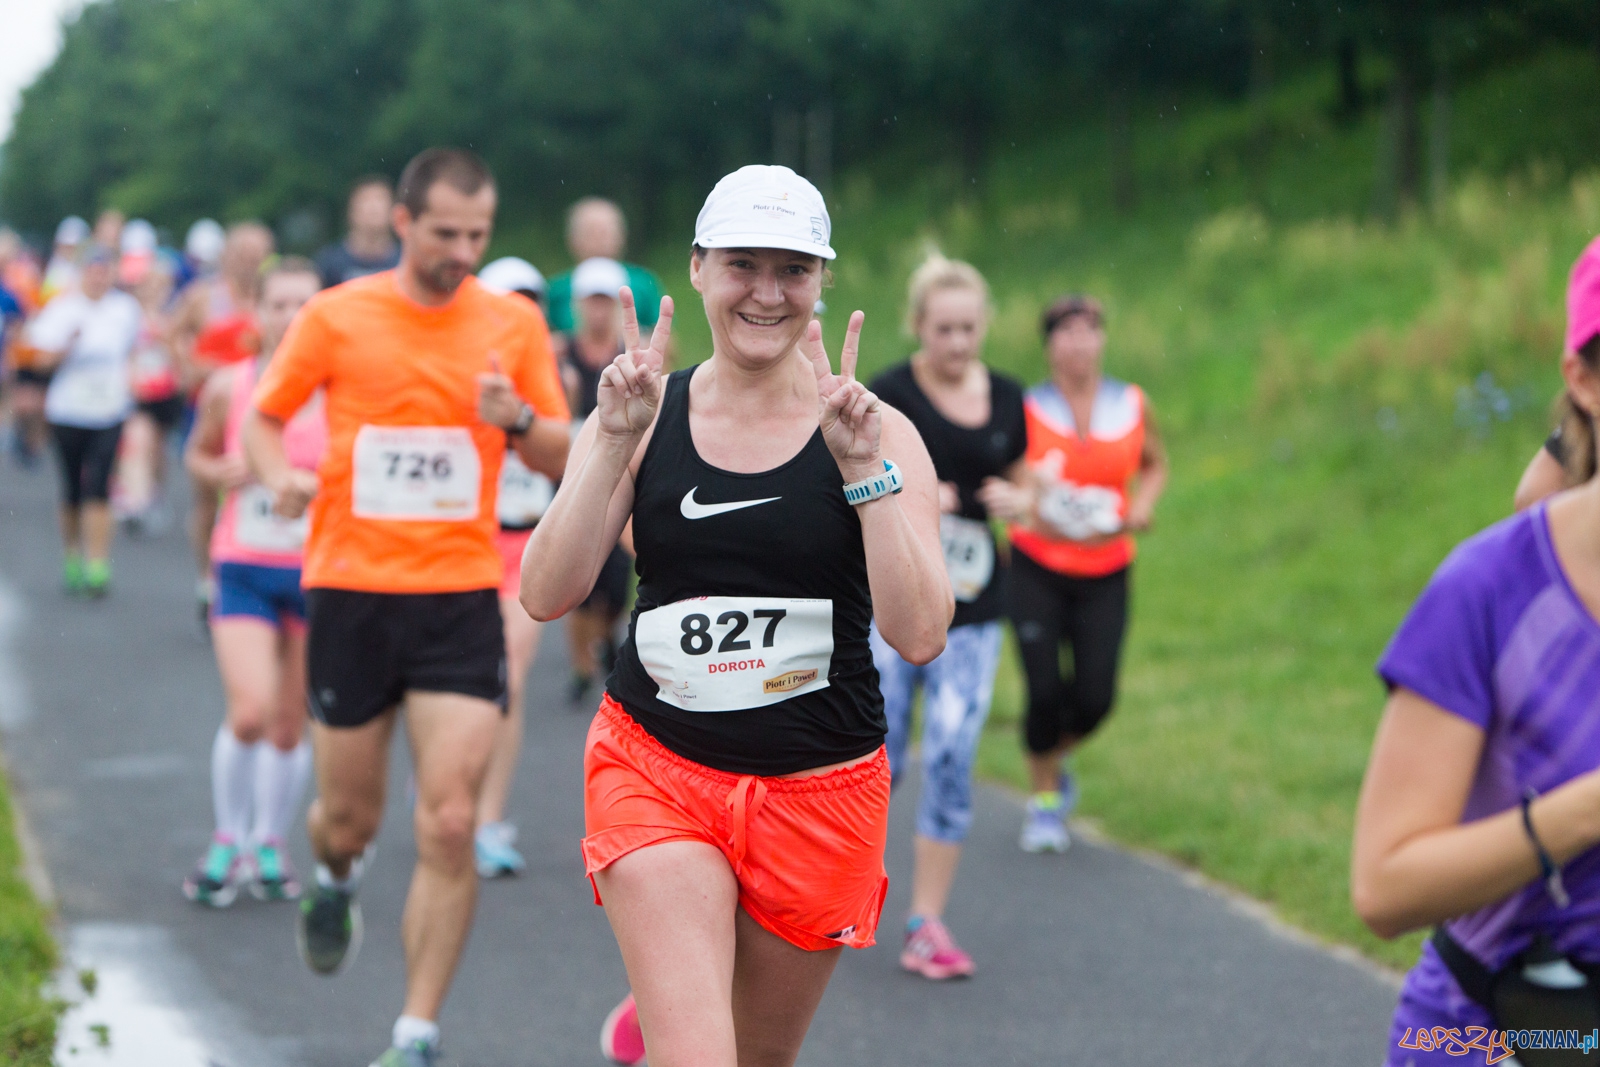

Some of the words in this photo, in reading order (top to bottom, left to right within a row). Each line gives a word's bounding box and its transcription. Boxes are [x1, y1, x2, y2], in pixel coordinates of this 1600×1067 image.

[380, 451, 453, 481] 726
[680, 609, 787, 655] 827
[708, 659, 766, 674] DOROTA
[765, 679, 787, 690] Piotr
